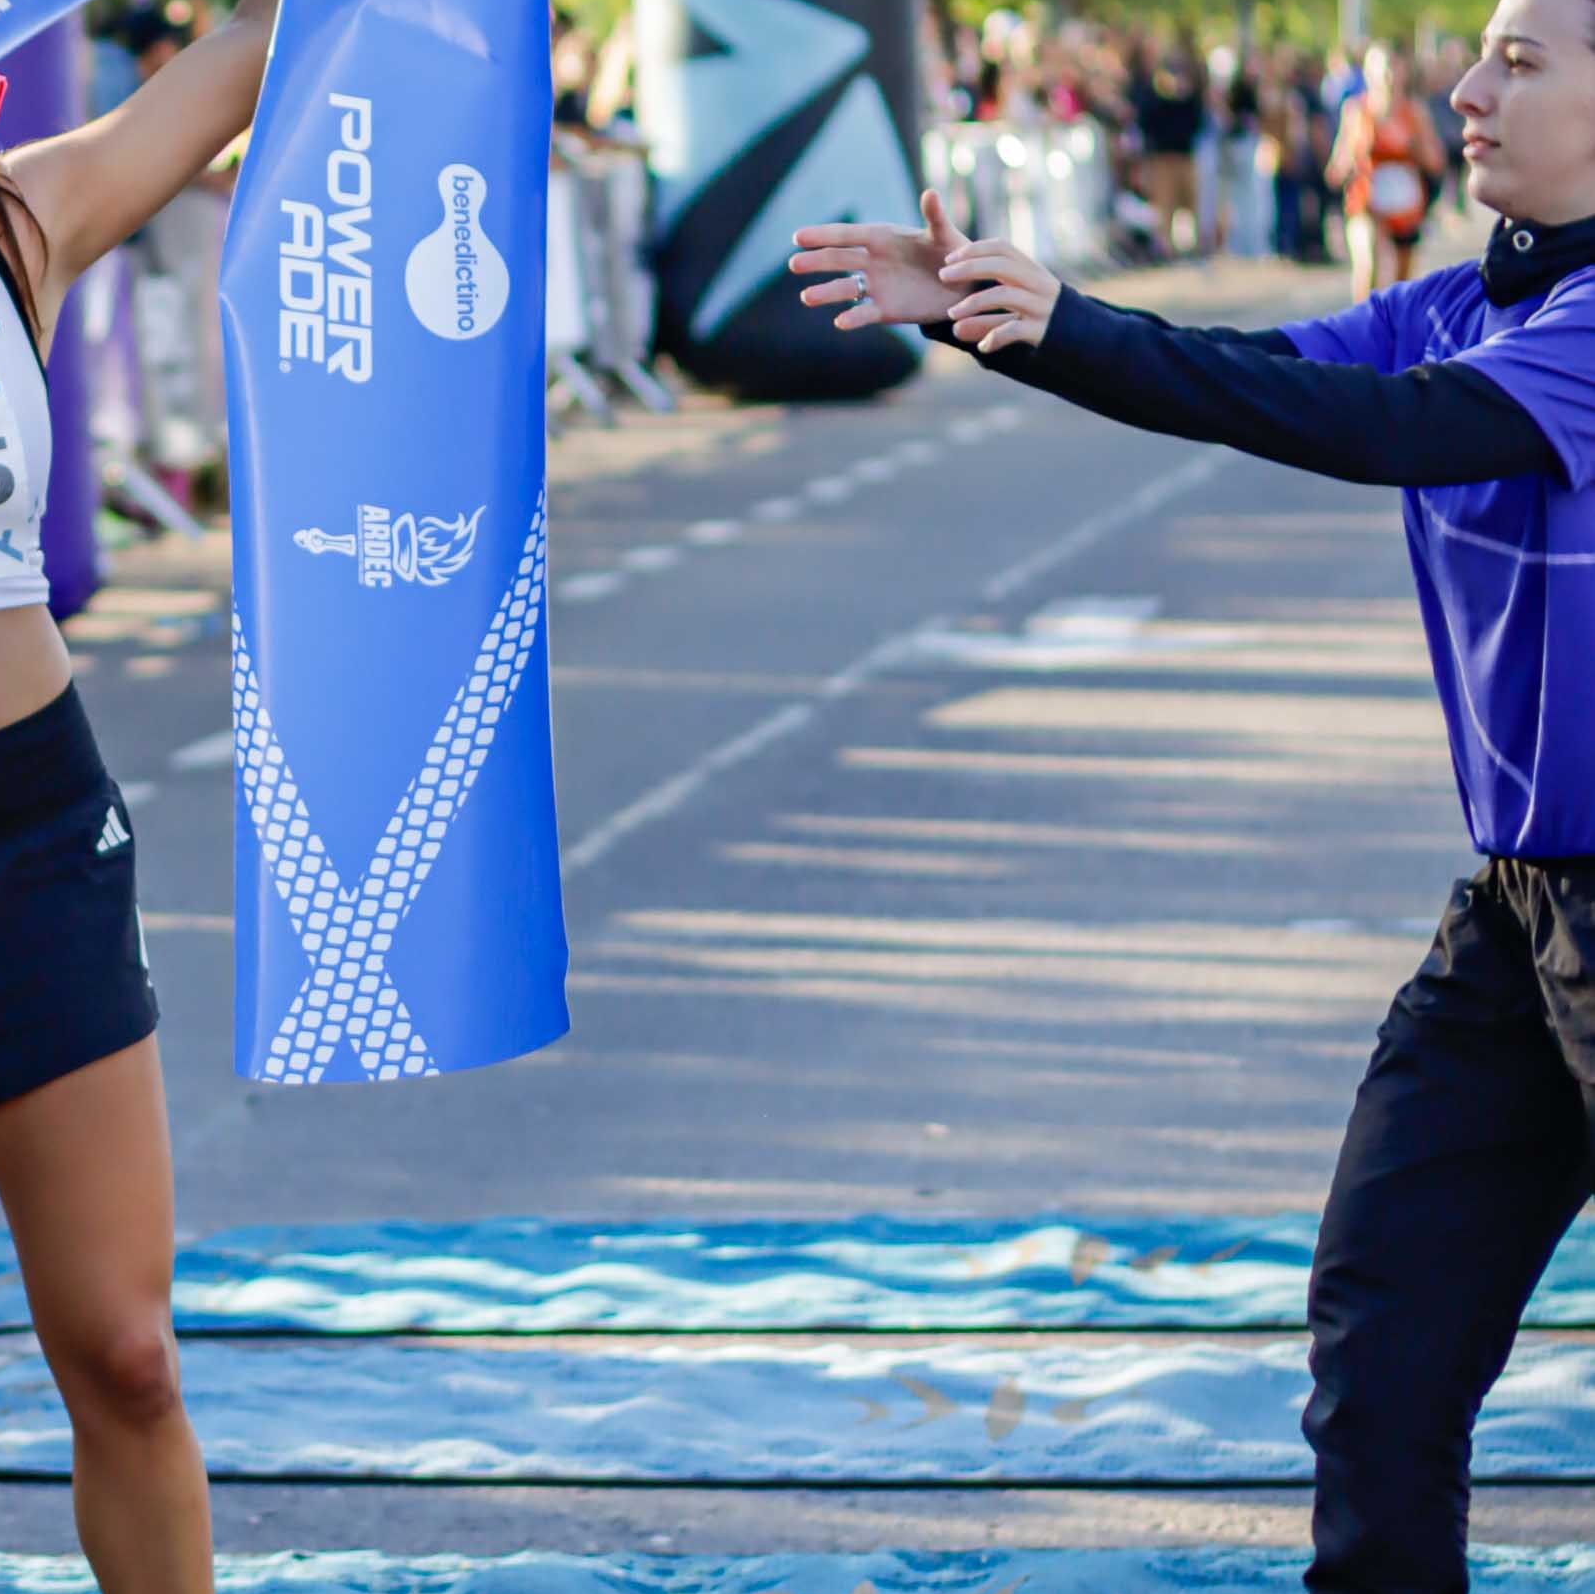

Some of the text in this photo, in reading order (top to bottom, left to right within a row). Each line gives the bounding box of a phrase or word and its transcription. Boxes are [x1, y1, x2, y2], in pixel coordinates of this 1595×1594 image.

[327, 92, 373, 384] POWER
[452, 174, 479, 333] benedictino
[363, 504, 392, 588] ARDEC
